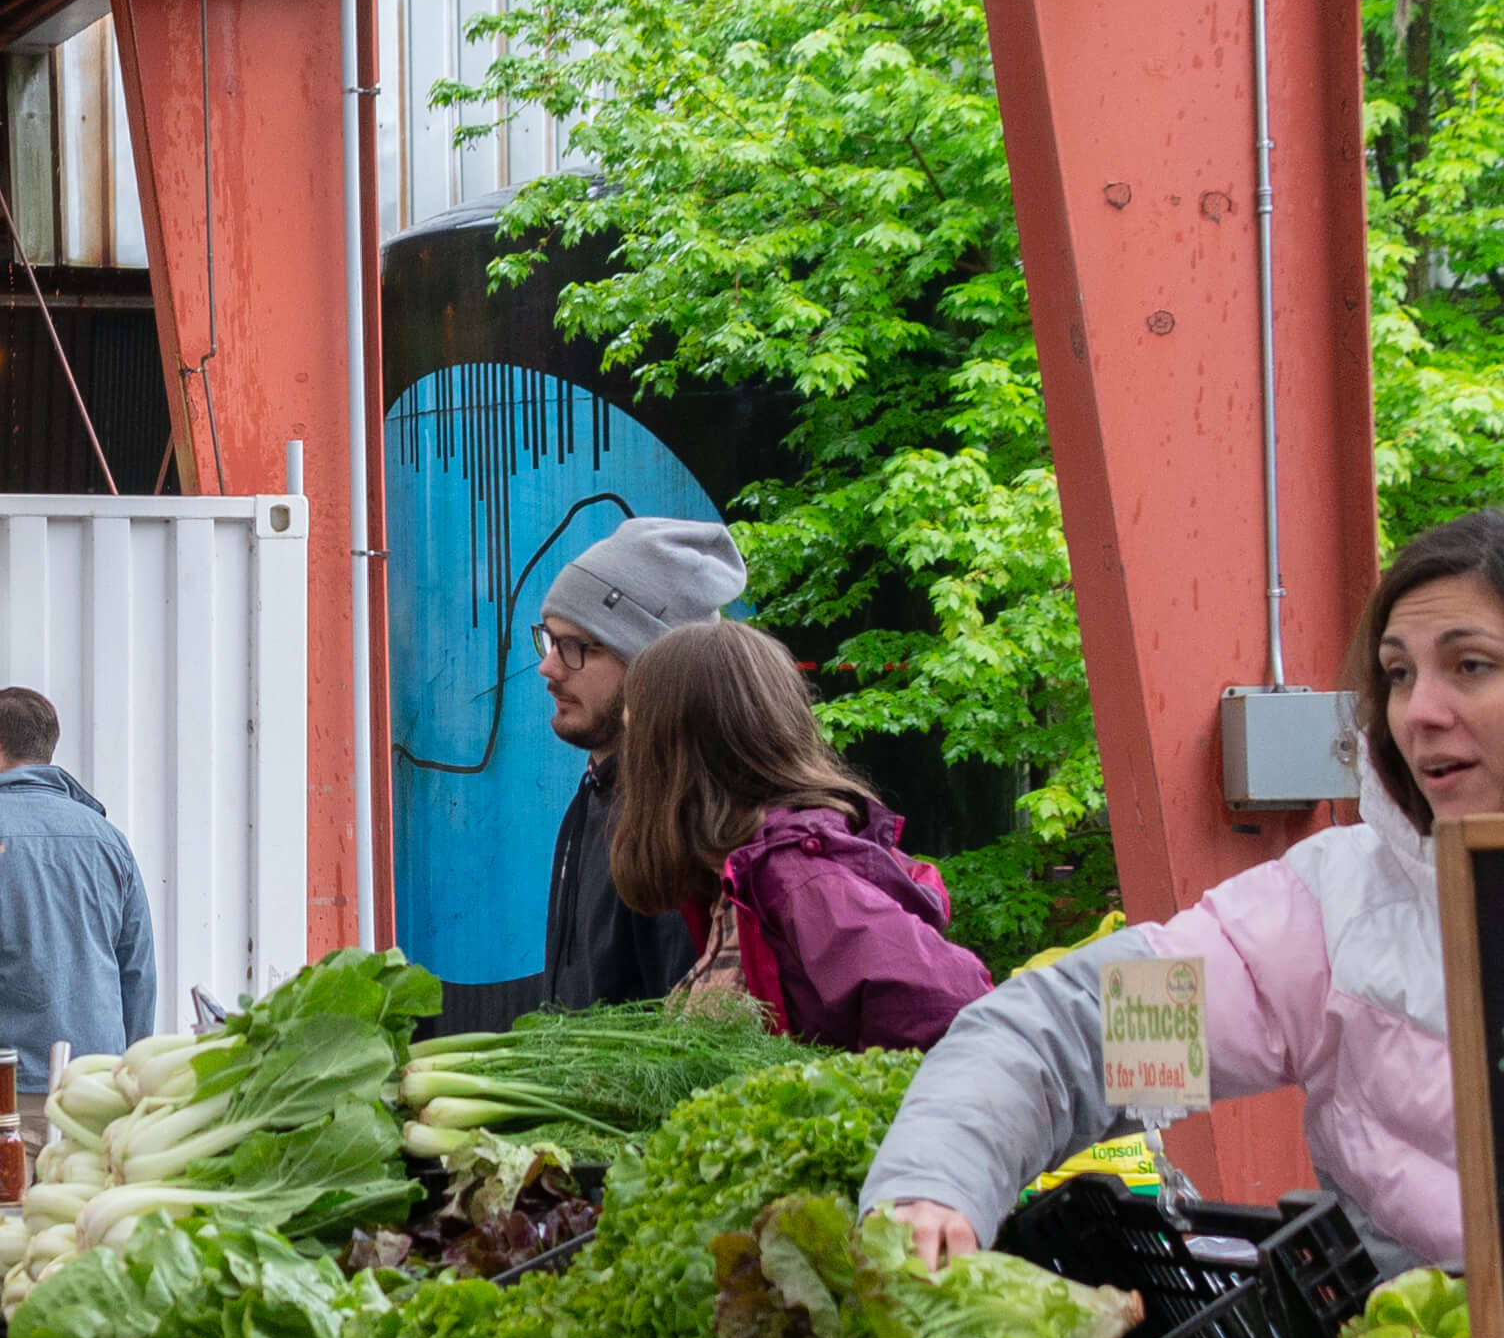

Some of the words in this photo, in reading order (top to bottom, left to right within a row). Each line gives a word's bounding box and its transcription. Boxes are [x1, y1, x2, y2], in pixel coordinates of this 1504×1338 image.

[1104, 994, 1200, 1042] lettuces
[1106, 1062, 1114, 1089] 3
[1117, 1062, 1135, 1089] for
[1159, 1062, 1185, 1088] deal
[1092, 1141, 1143, 1160] Topsoil
